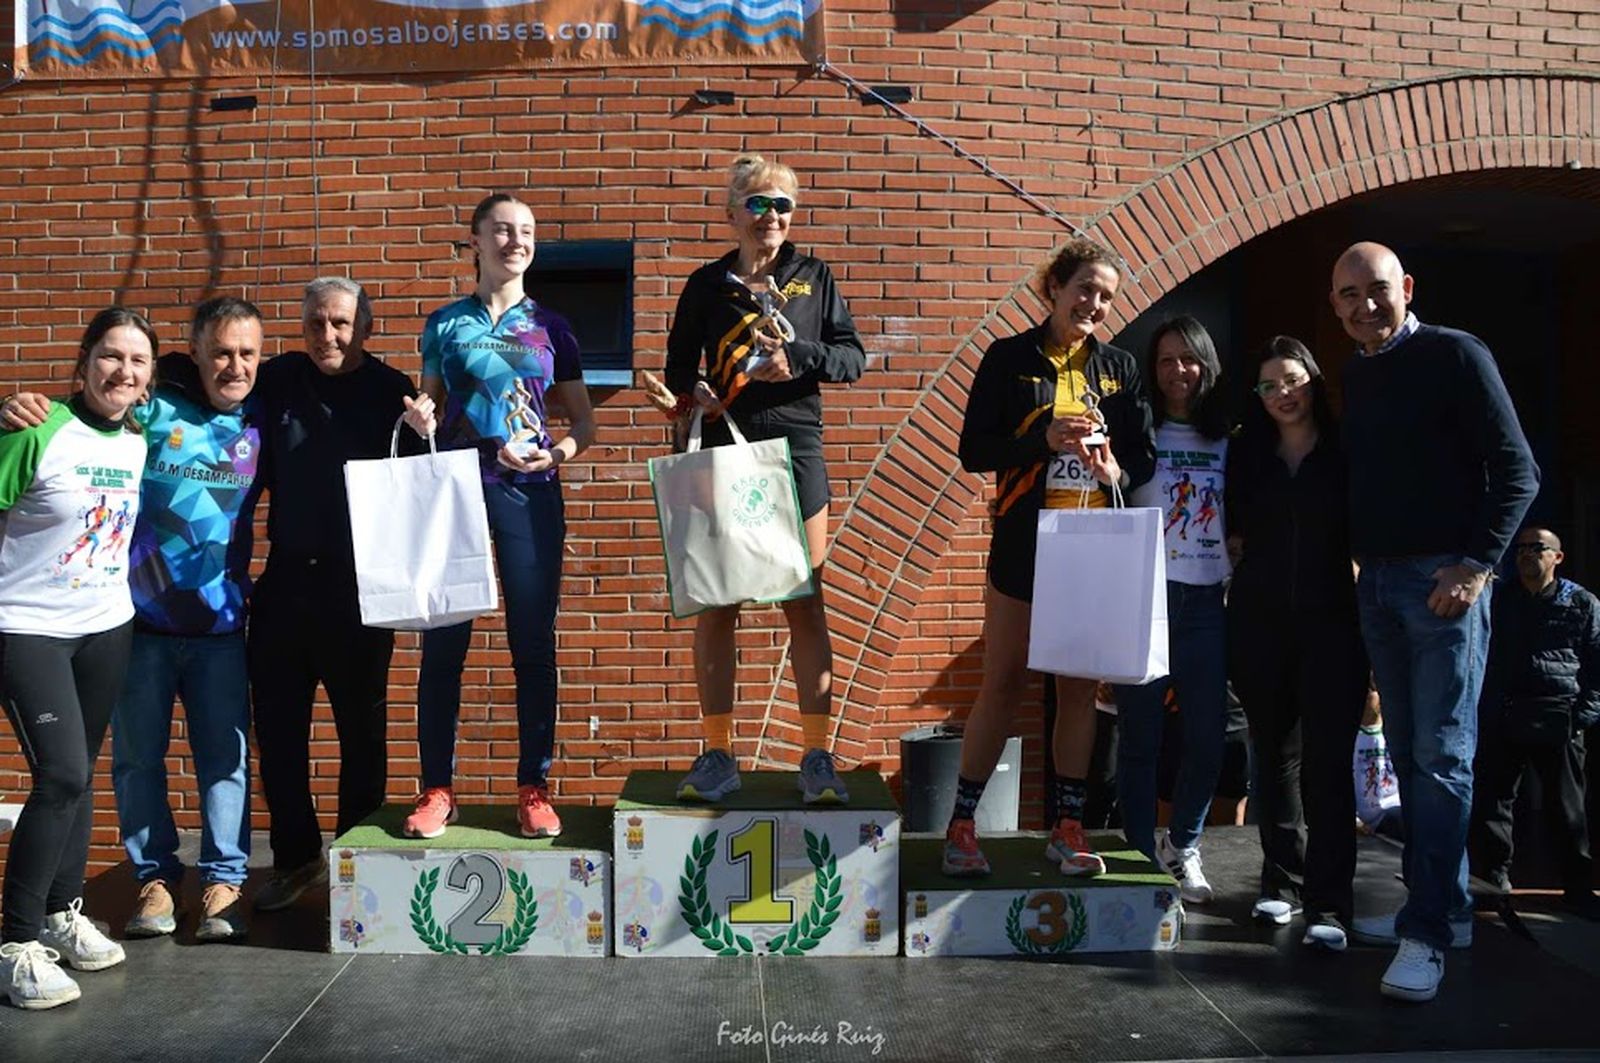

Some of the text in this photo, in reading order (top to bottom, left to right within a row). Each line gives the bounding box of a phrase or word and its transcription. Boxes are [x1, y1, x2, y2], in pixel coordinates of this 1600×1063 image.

[211, 19, 619, 49] www.somosalbojenses.com
[446, 852, 505, 945] 2
[726, 816, 797, 926] 1
[1025, 889, 1068, 947] 3
